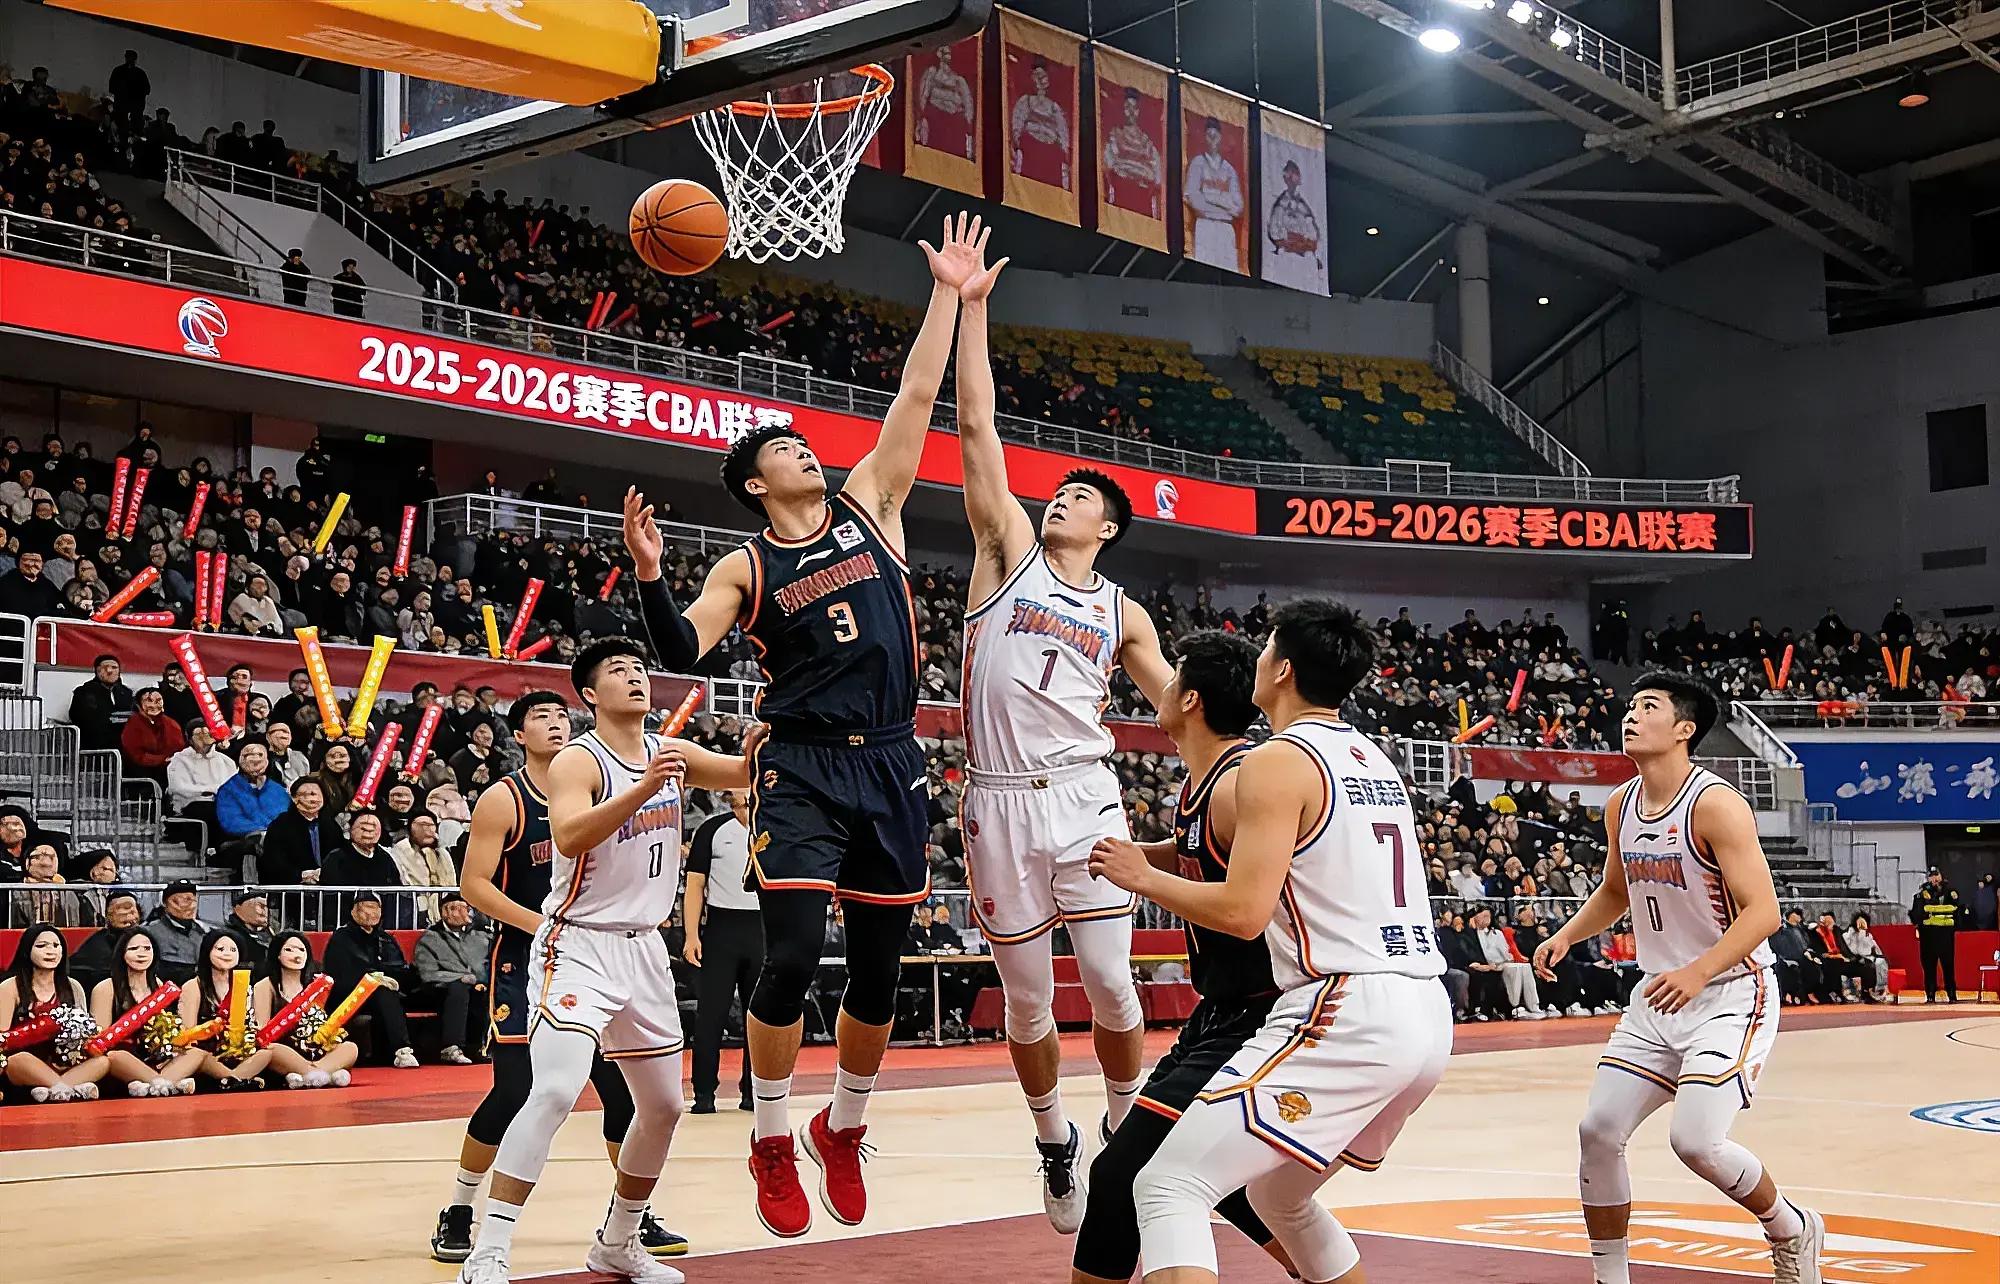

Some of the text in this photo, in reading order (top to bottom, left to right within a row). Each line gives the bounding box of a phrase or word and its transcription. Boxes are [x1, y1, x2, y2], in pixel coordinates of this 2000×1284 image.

[1284, 498, 1717, 551] 2025-2026赛季CBA联赛
[828, 602, 858, 643] 3
[1039, 649, 1058, 690] 1
[1372, 823, 1407, 907] 7
[1645, 895, 1663, 931] 0
